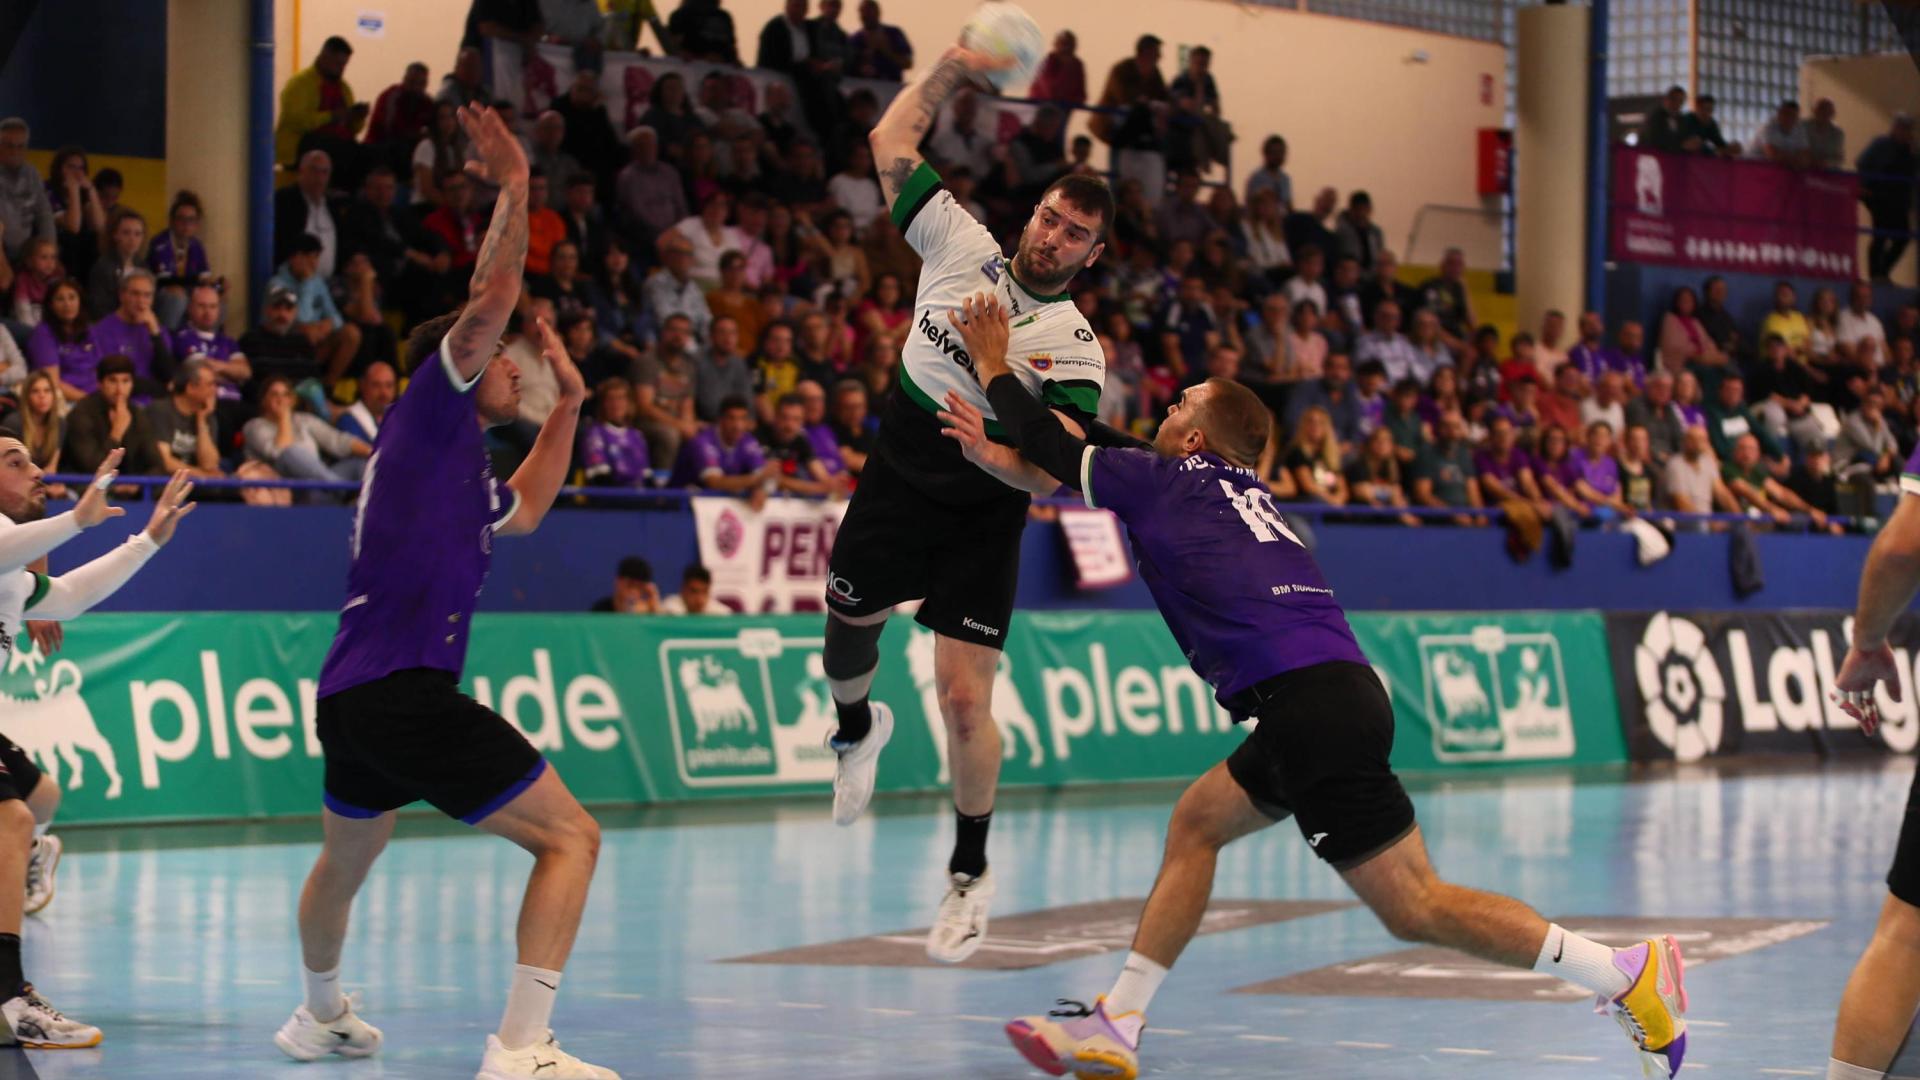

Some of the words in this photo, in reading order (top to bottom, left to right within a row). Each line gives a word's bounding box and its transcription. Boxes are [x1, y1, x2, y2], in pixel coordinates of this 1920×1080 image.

[918, 309, 980, 384] helve
[962, 616, 1000, 636] Kempa
[129, 648, 622, 790] plede
